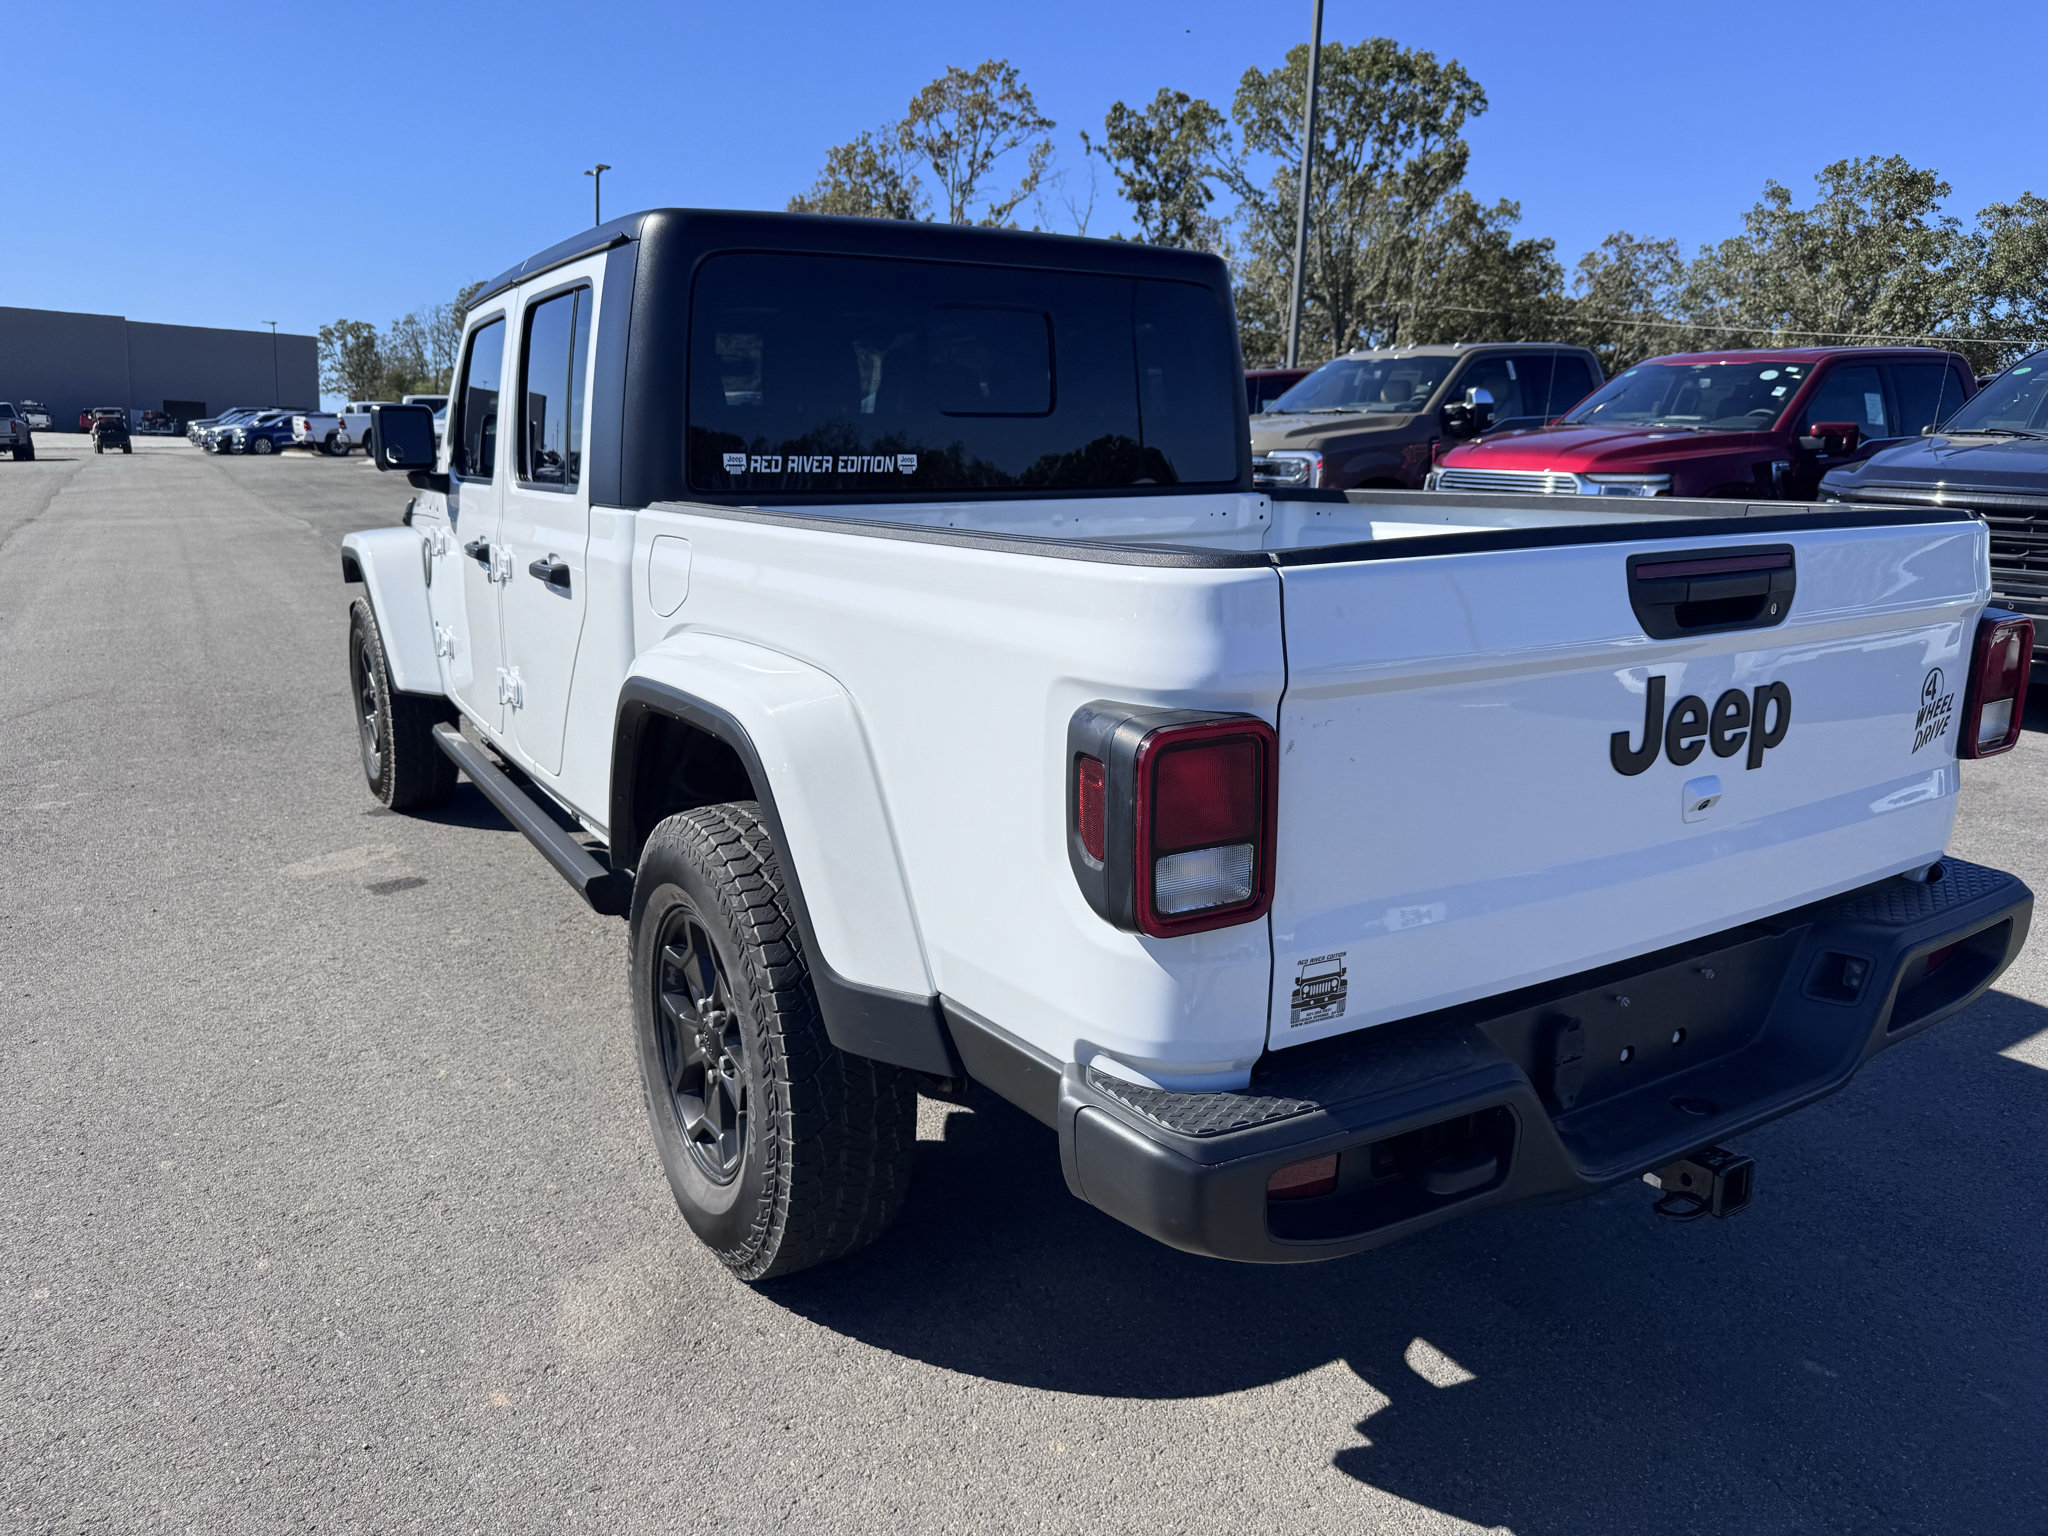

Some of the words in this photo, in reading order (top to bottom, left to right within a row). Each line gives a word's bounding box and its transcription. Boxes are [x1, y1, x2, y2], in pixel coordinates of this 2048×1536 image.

[727, 455, 744, 464] Jeep
[750, 455, 782, 473] RED
[787, 455, 833, 473] RIVER
[838, 455, 895, 473] EDITION
[900, 456, 915, 464] Jeep
[1914, 692, 1955, 731] WHEEL
[1610, 675, 1792, 777] Jeep
[1911, 715, 1951, 755] DRIVE
